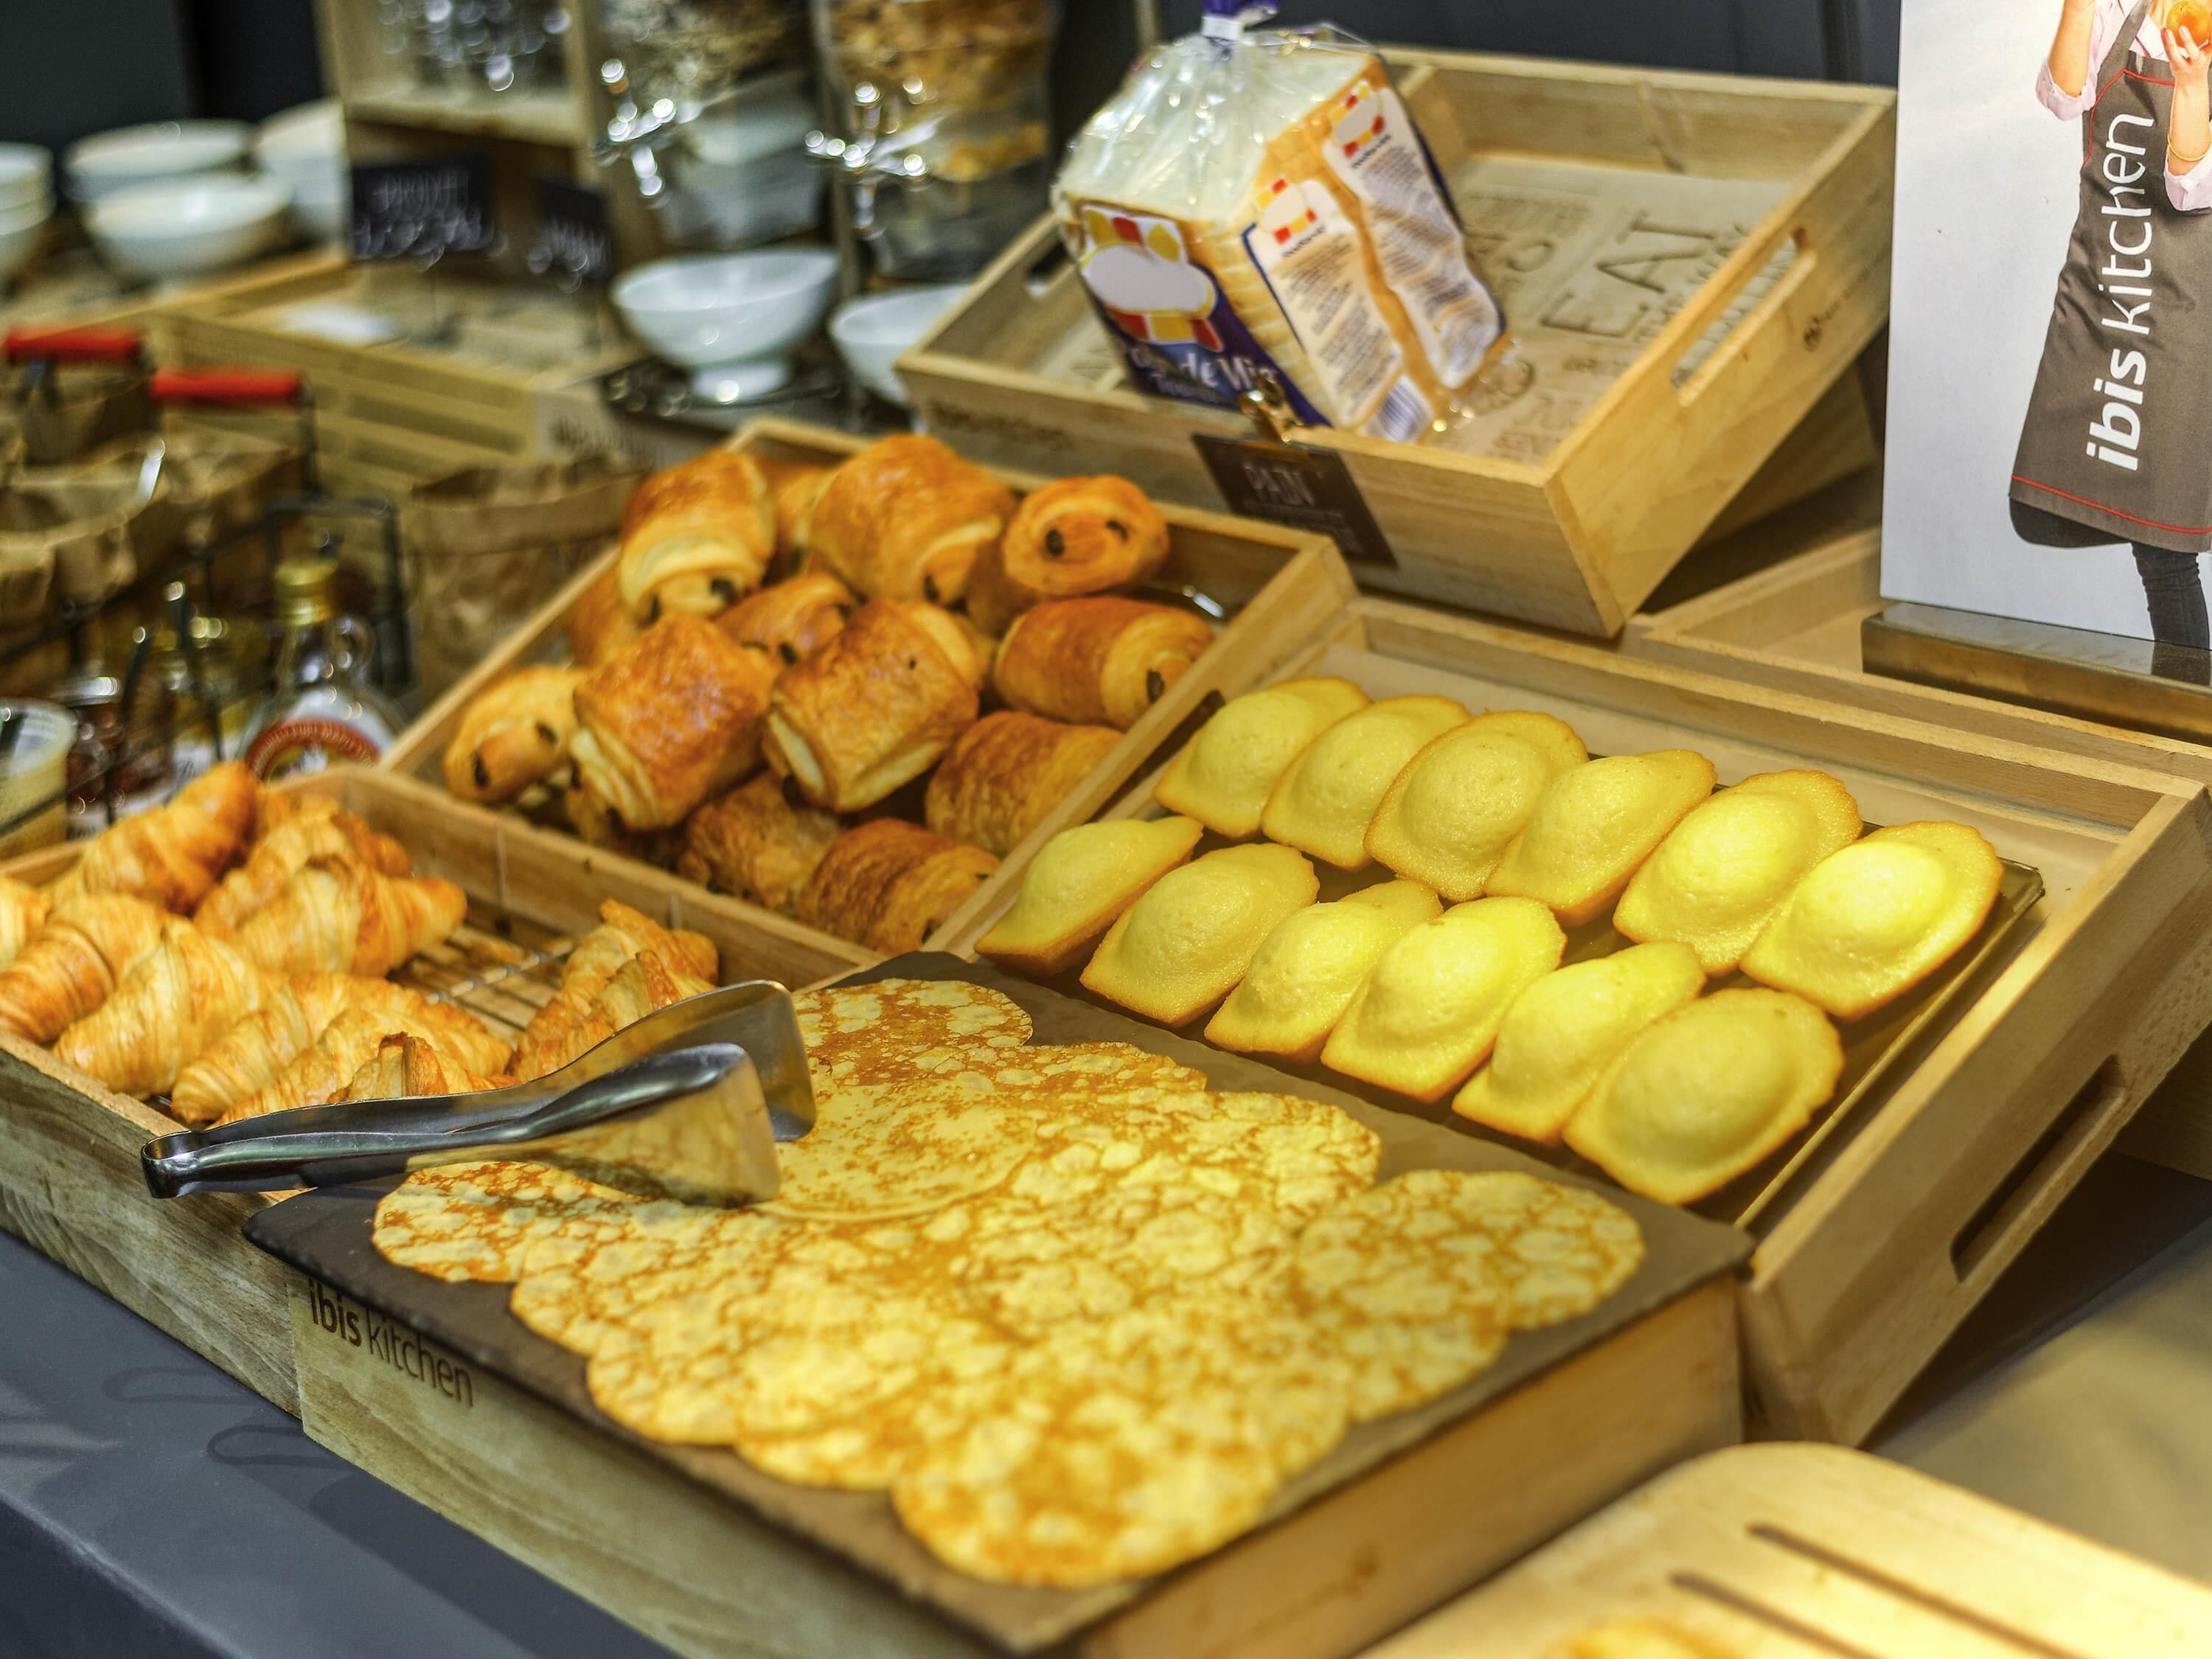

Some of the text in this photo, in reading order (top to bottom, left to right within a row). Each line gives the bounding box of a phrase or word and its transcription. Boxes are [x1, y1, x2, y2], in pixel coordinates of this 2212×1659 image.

[1539, 209, 1717, 339] EAT
[2087, 113, 2154, 471] ibis kitchen
[307, 1277, 474, 1407] ibis kitchen
